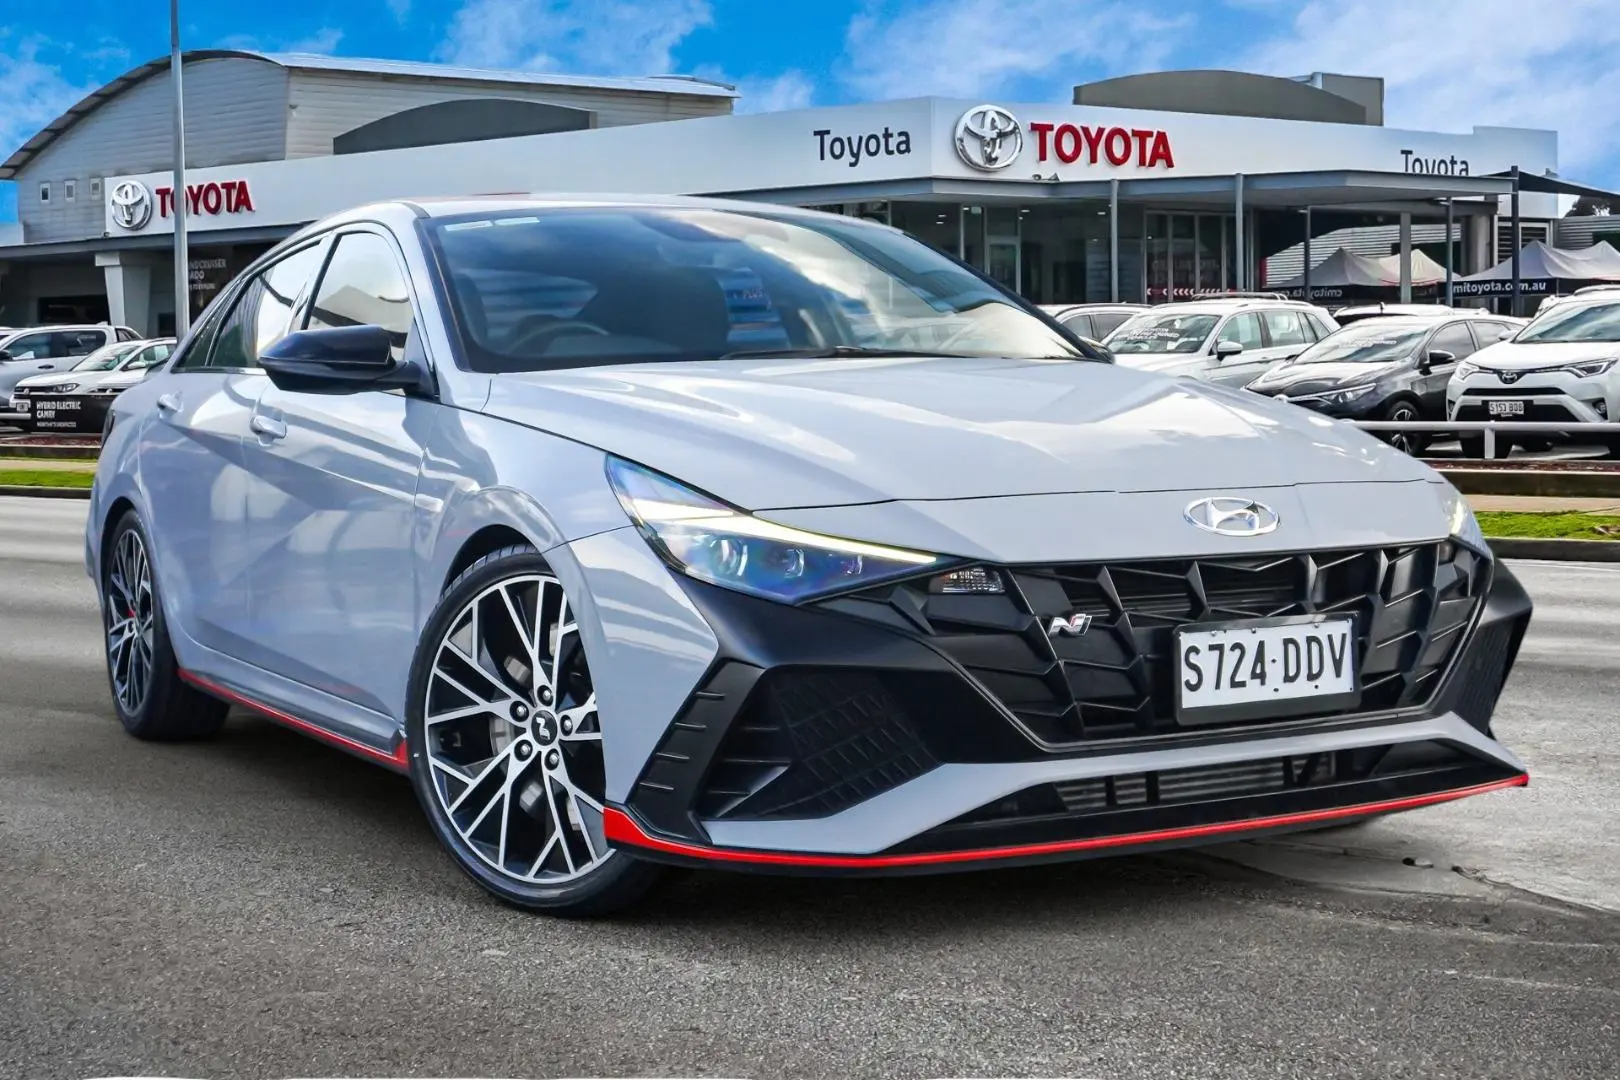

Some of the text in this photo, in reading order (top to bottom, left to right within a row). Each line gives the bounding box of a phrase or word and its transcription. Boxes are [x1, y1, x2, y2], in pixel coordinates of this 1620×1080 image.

[813, 127, 912, 167] Toyota
[1030, 122, 1174, 168] TOYOTA
[1453, 281, 1547, 294] mitoyota.cm.au
